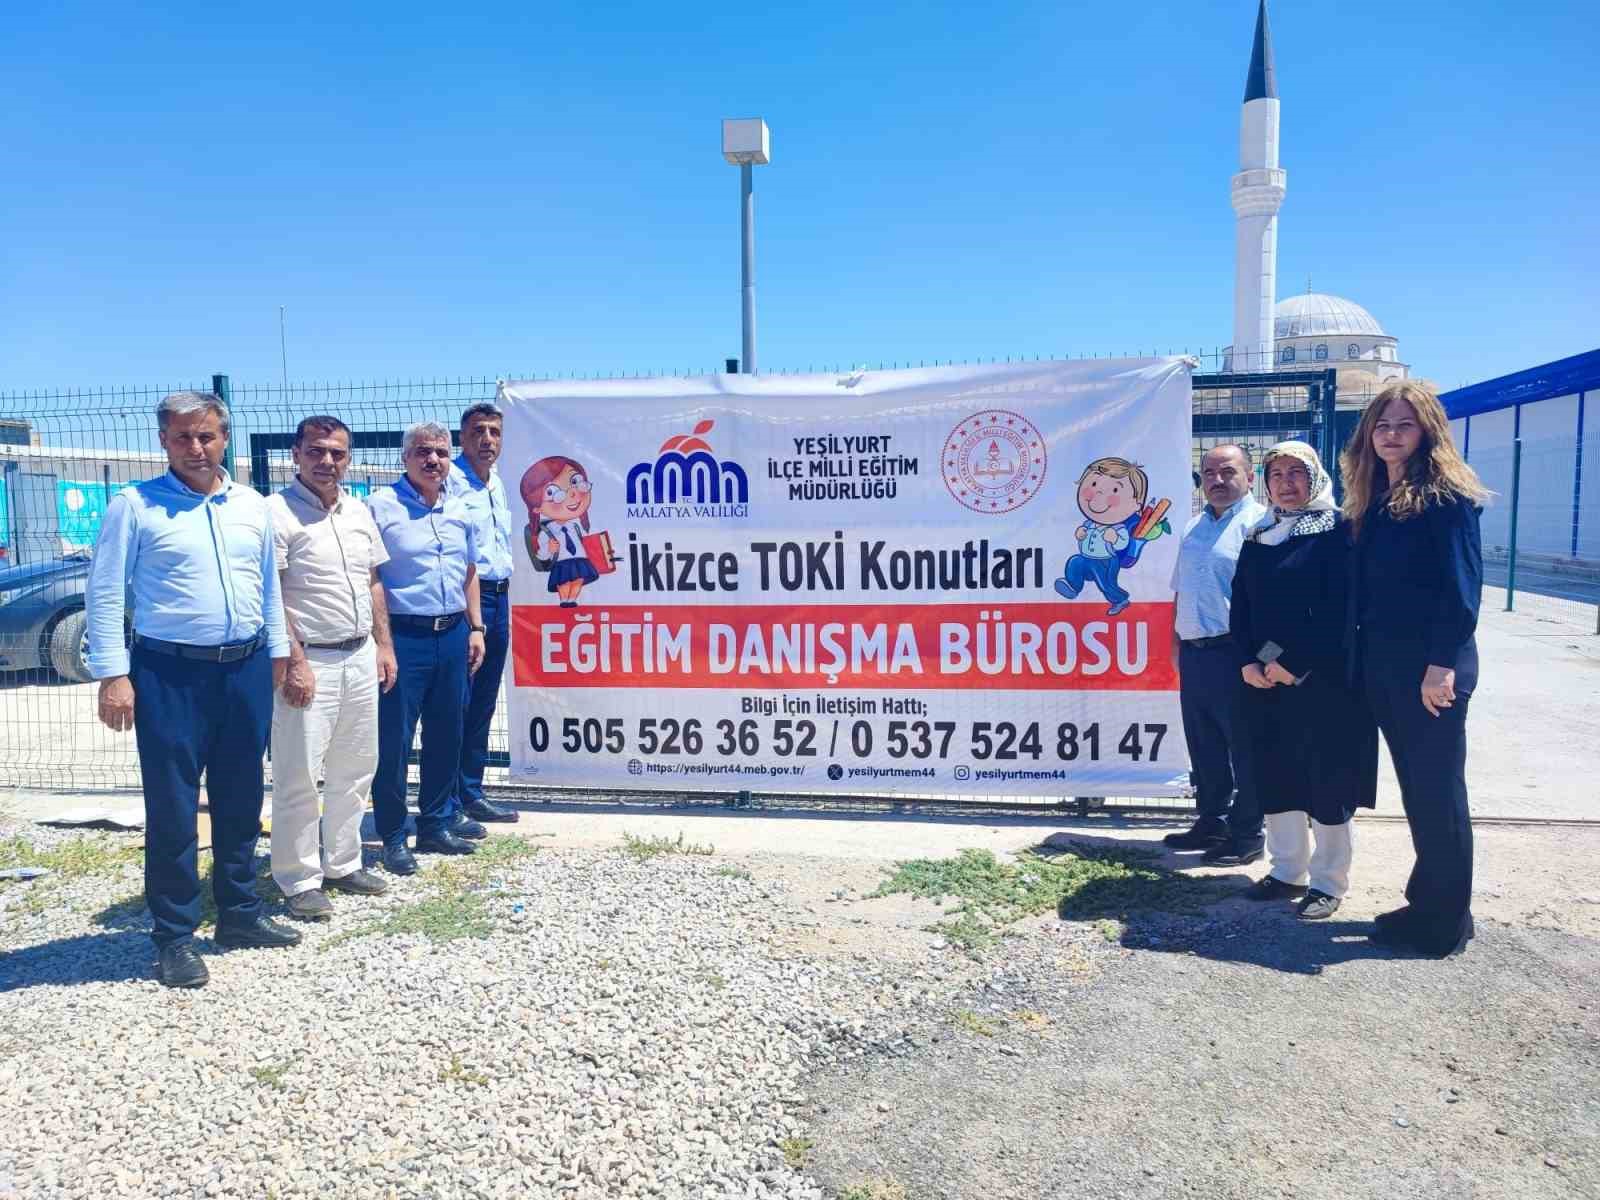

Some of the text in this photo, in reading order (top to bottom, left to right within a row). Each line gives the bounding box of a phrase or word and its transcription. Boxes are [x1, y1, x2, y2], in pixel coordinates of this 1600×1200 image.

[793, 434, 892, 458] YEŞİLYURT
[768, 455, 918, 481] İLÇE MİLLİ EĞİTİM
[788, 478, 897, 501] MÜDÜRLÜĞÜ
[627, 504, 749, 519] MALATYA VALİLİĞİ
[629, 530, 1044, 592] İkizce TOKİ Konutları
[540, 610, 1149, 685] EĞİTİM DANIŞMA BÜROSU
[741, 694, 928, 718] Bilgi İçin İletişim Hattı;
[529, 716, 1168, 762] 0 505 526 36 52 / 0 537 524 81 47
[646, 762, 806, 777] https://yesilyurt44.meb.gov.tr/
[848, 766, 936, 779] yesilyurtmem44
[975, 768, 1067, 781] yesilyurtmem44
